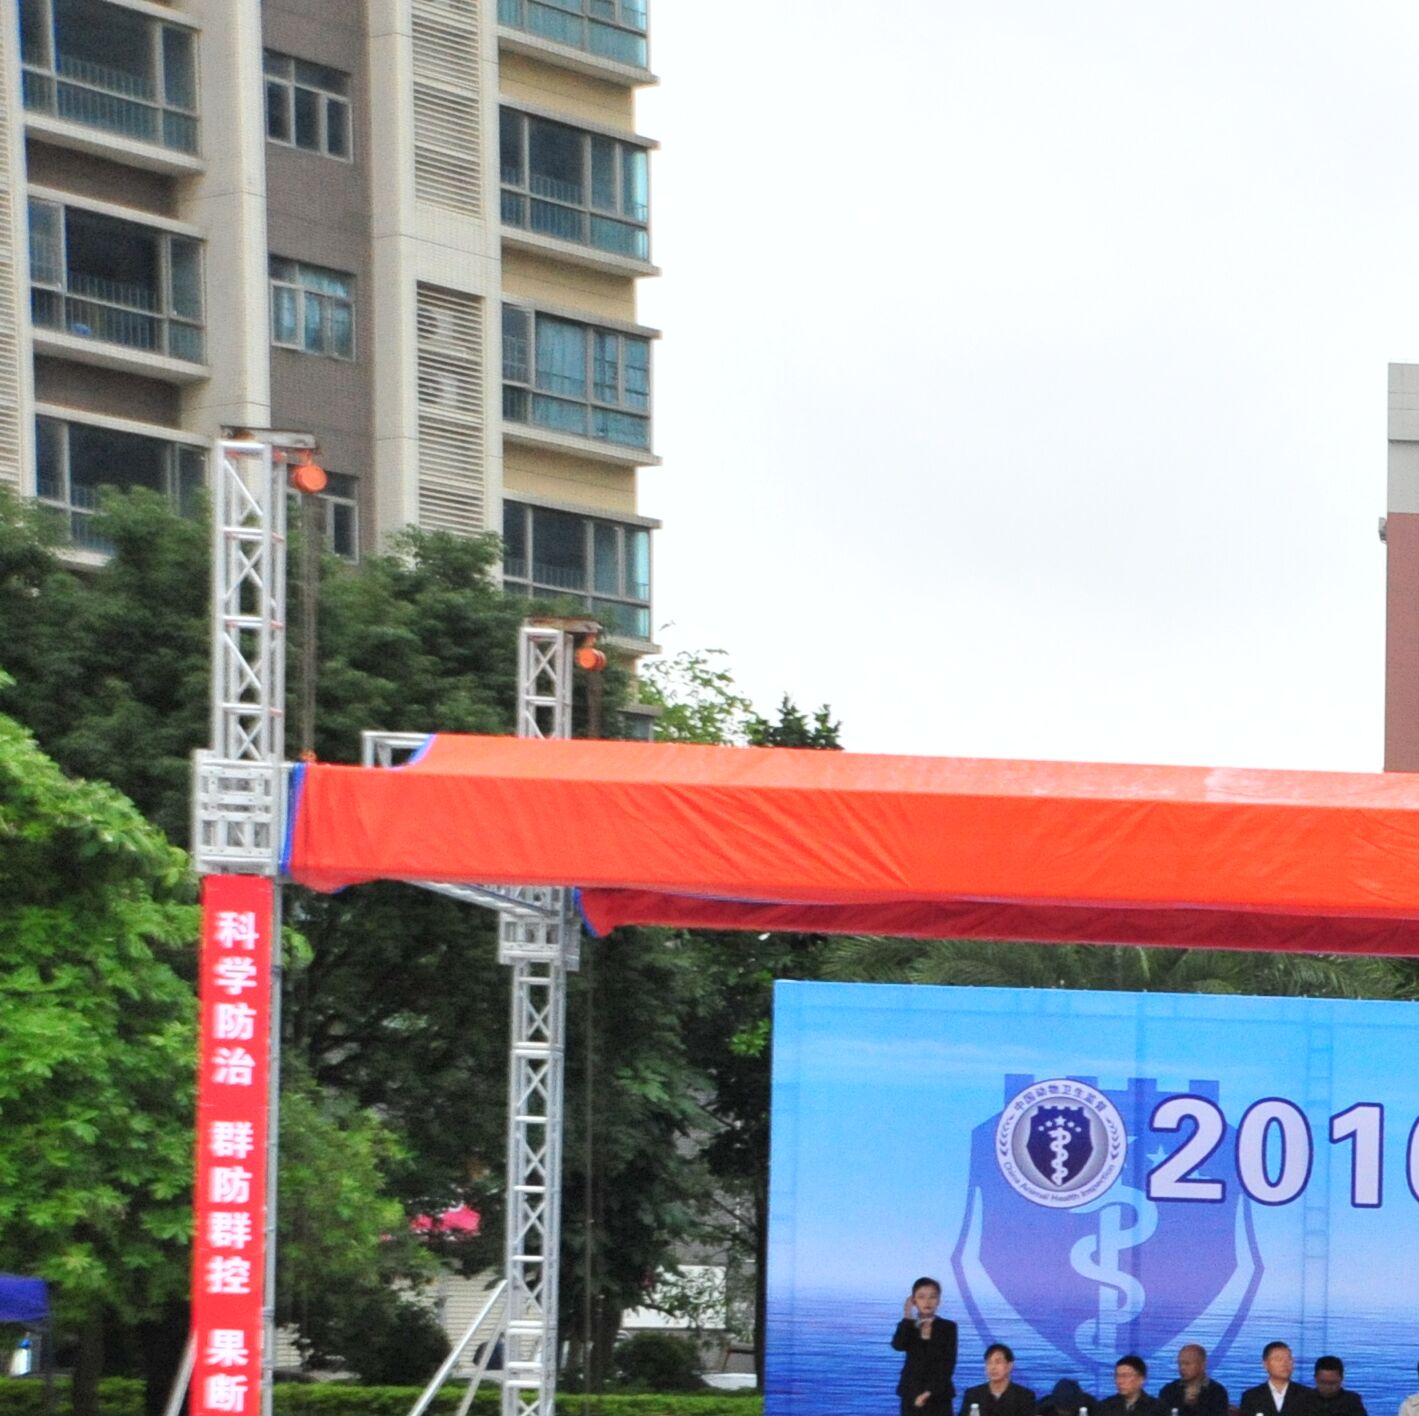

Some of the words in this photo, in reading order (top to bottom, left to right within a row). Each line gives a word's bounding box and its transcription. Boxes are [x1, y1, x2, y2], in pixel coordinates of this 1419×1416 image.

[211, 910, 261, 1086] 科学防治
[208, 1120, 254, 1296] 群防群控
